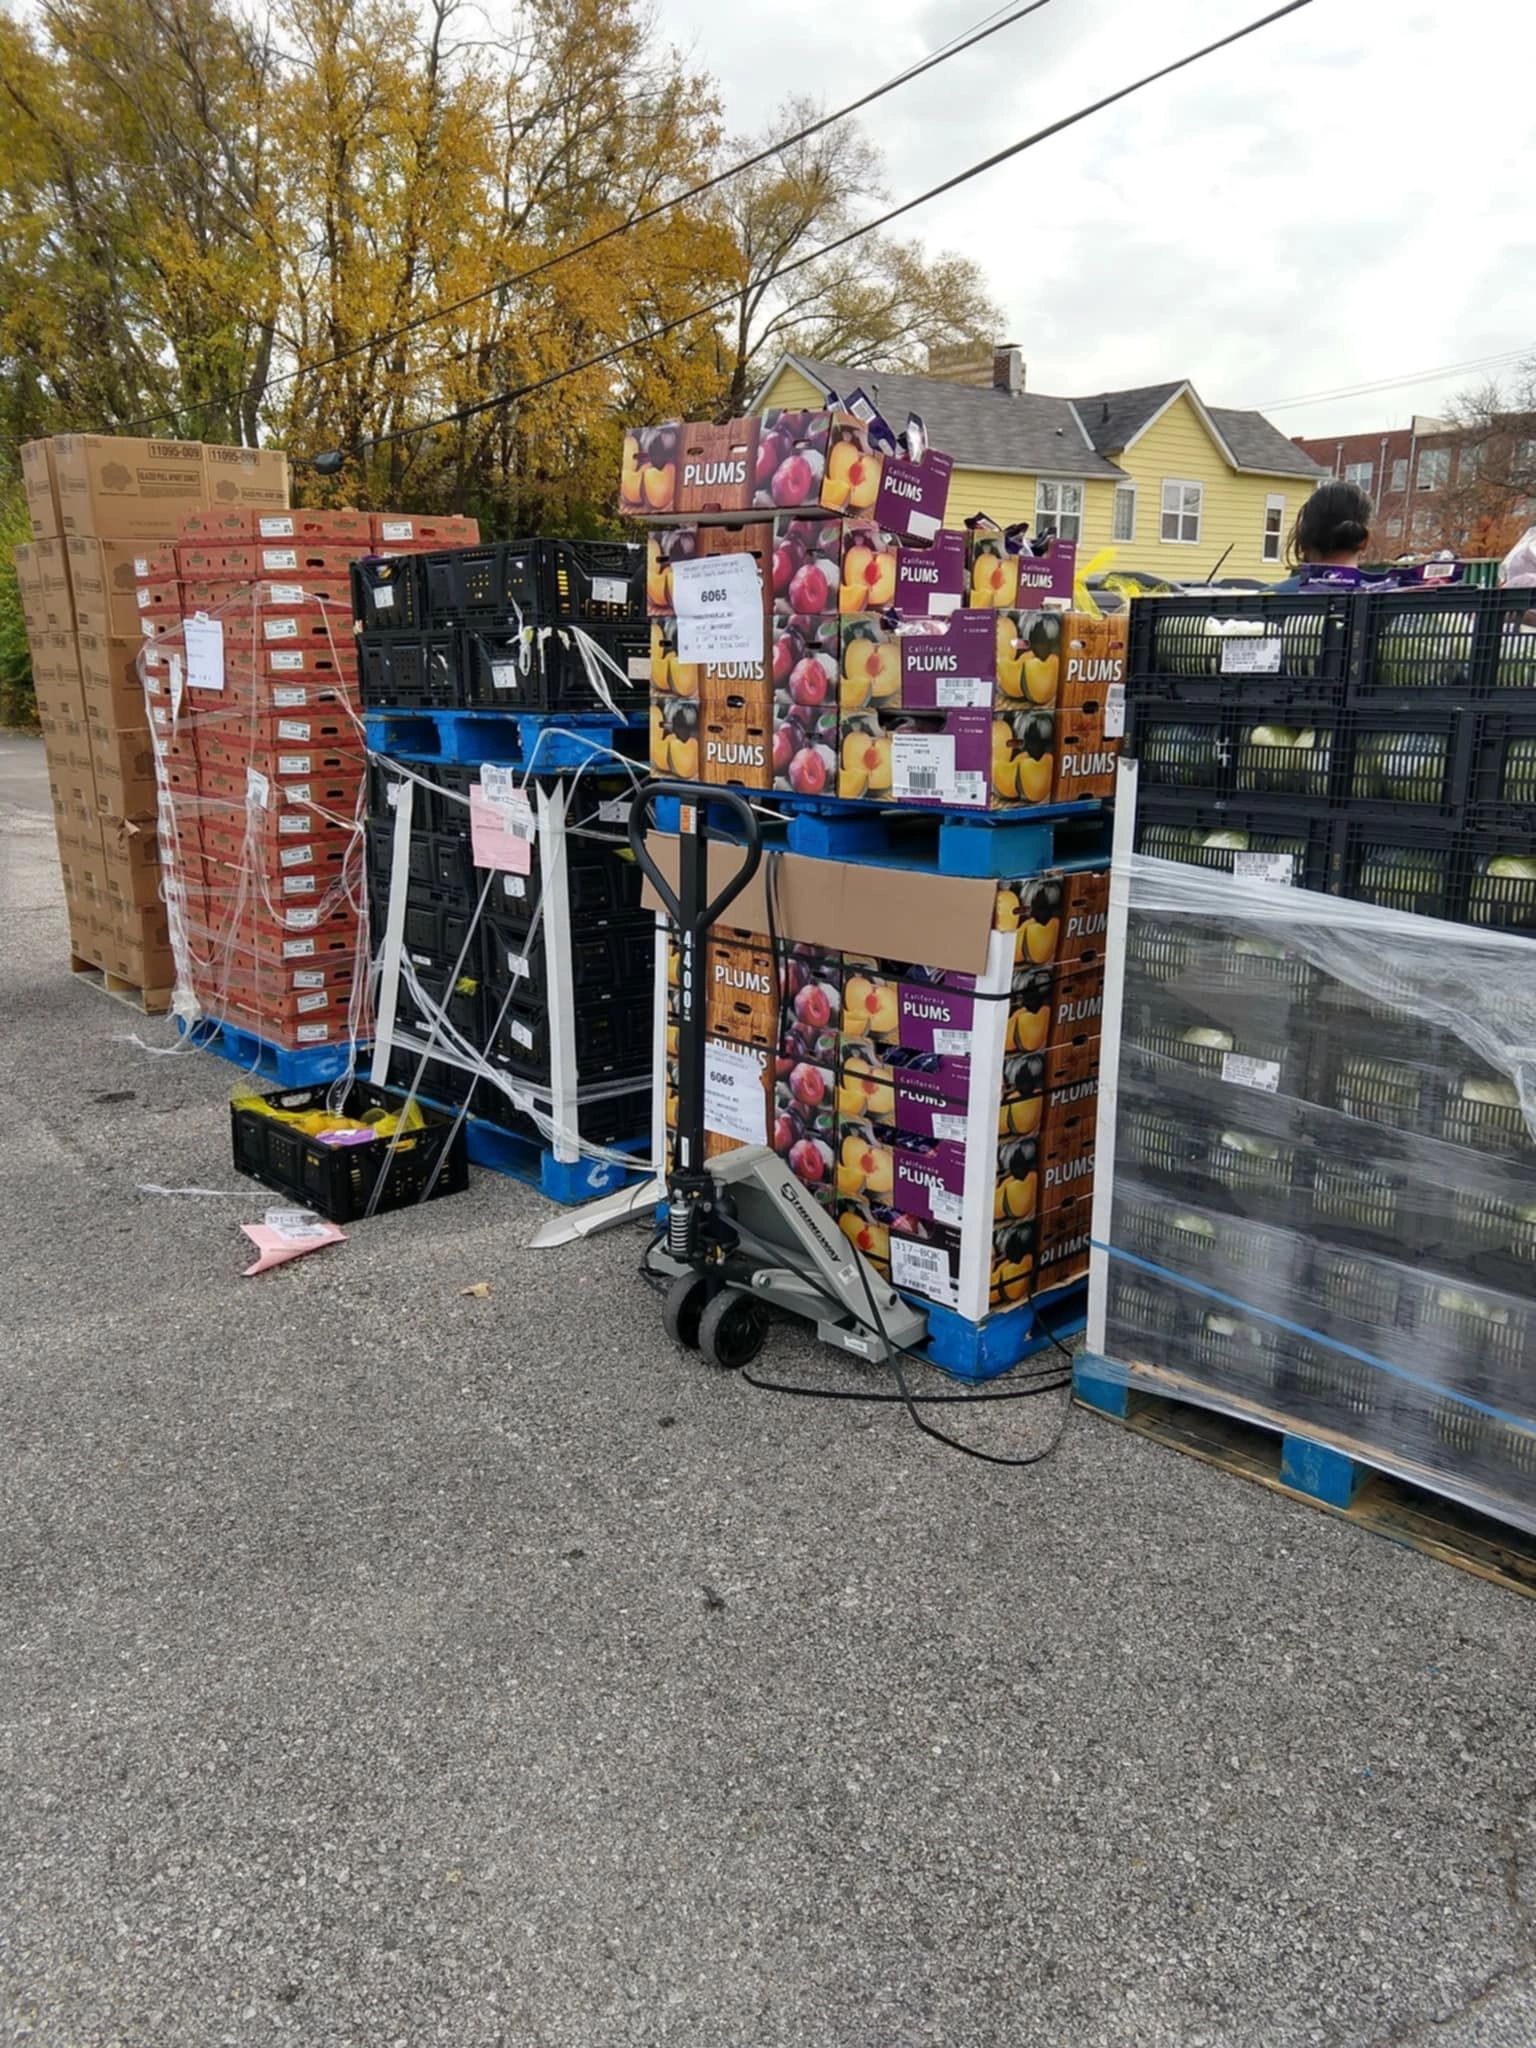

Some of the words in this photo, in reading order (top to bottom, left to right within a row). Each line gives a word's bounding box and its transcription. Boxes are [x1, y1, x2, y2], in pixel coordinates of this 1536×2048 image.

[150, 445, 200, 458] 11095-009
[684, 461, 746, 486] PLUMS
[888, 466, 921, 484] California
[884, 476, 922, 502] PLUMS
[902, 557, 935, 566] California
[901, 567, 939, 583] PLUMS
[1021, 573, 1053, 588] PLUMS
[701, 589, 727, 602] 6065
[908, 645, 951, 653] California
[707, 662, 764, 680] PLUMS
[907, 656, 958, 671] PLUMS
[1067, 659, 1122, 682] PLUMS
[707, 742, 764, 766] PLUMS
[1061, 753, 1115, 777] PLUMS
[1066, 912, 1108, 939] PLUM
[715, 965, 771, 994] PLUMS
[904, 993, 945, 1005] California
[903, 1001, 951, 1022] PLUMS
[1057, 996, 1103, 1025] PLUM
[710, 1071, 734, 1086] 6065
[900, 1077, 941, 1090] California
[900, 1158, 939, 1174] California
[1044, 1153, 1095, 1188] PLUMS
[899, 1166, 945, 1191] PLUMS
